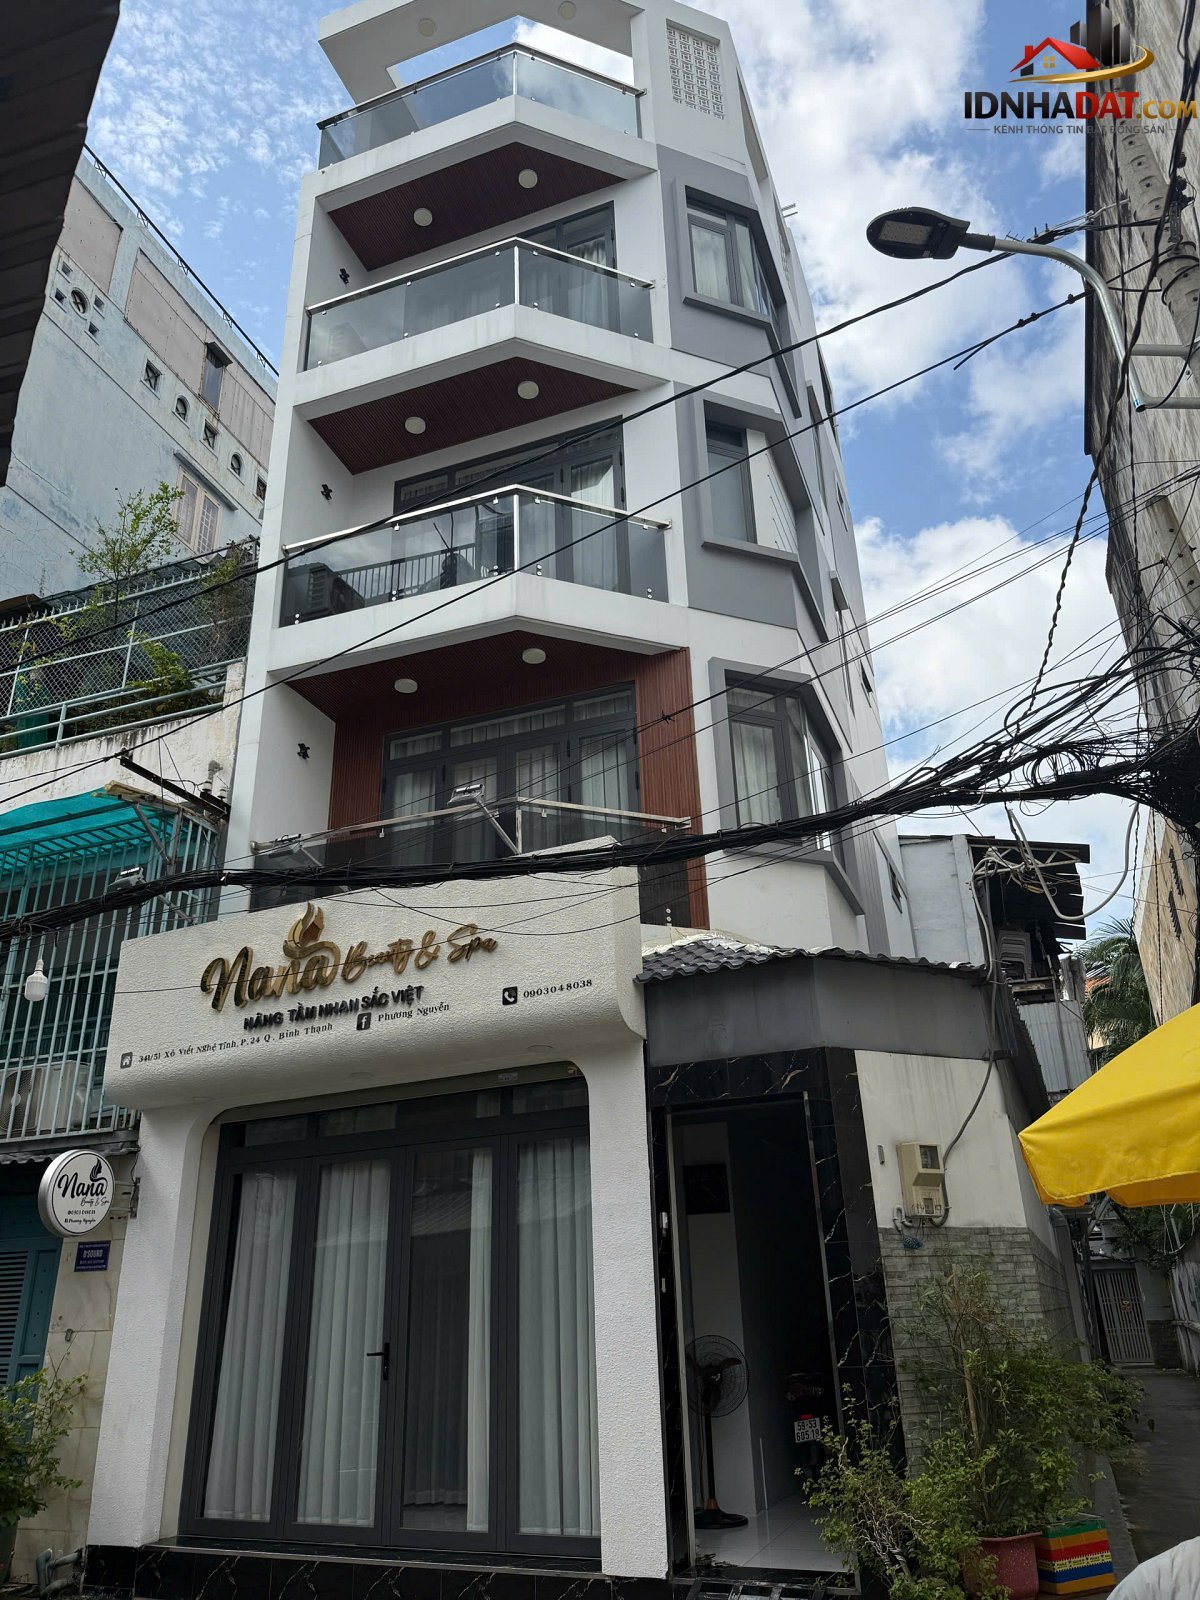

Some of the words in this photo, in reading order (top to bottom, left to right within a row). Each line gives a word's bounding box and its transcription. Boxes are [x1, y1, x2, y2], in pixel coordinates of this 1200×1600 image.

[200, 940, 341, 1012] Nana
[414, 930, 440, 970] &
[446, 923, 499, 964] Spa
[391, 985, 425, 1006] VIỆT
[378, 1009, 414, 1022] Phương
[417, 1001, 450, 1017] Nguyễn
[304, 1023, 333, 1036] Thạnh
[57, 1172, 108, 1199] Nana
